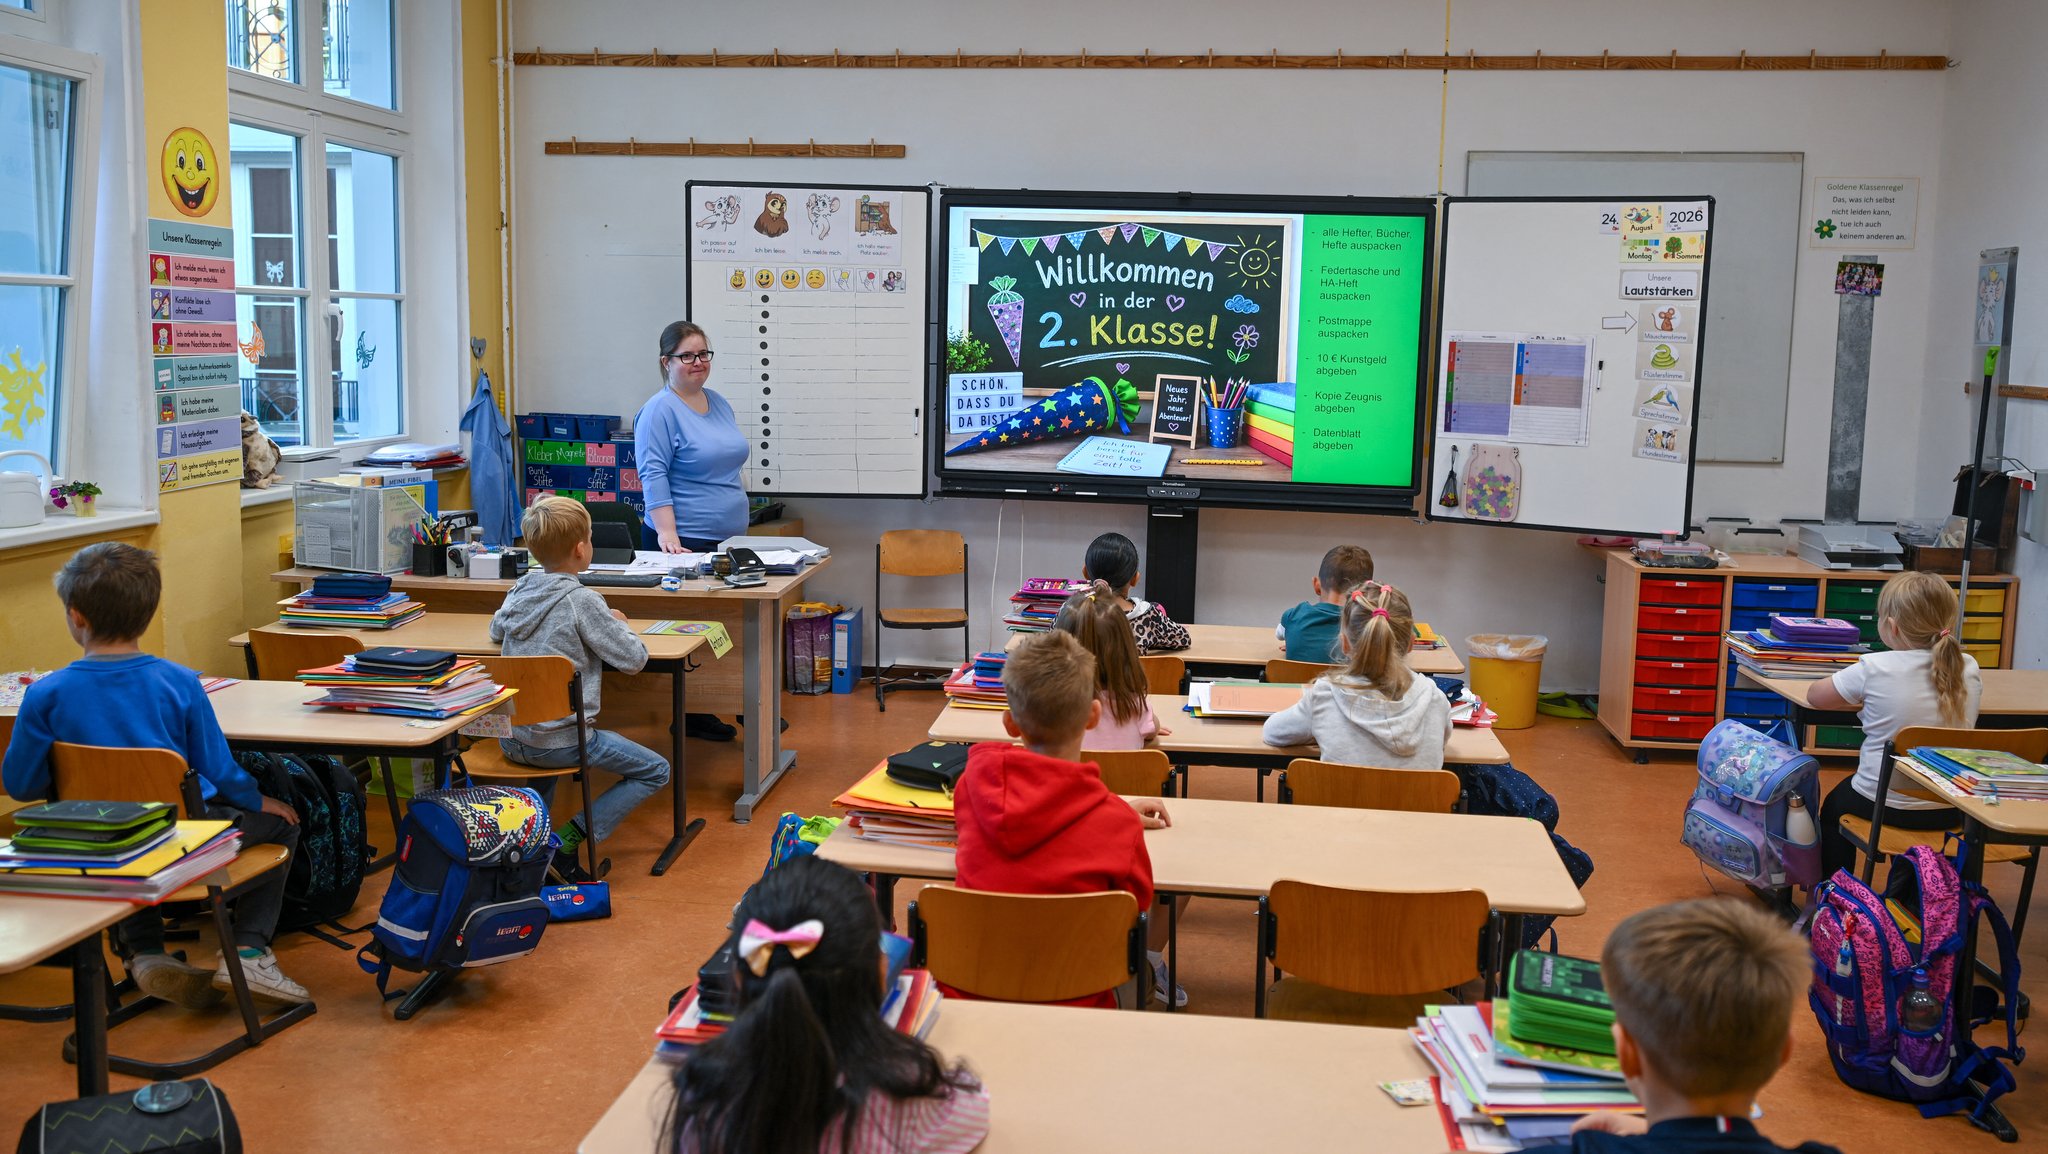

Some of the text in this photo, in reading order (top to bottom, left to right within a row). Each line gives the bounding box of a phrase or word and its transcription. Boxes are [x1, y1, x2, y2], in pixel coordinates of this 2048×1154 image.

[1827, 183, 1904, 192] Goldene Klassenregel
[1832, 196, 1847, 204] Das,
[1601, 214, 1619, 225] 24.
[1669, 210, 1703, 224] 2026
[1322, 228, 1412, 239] alle Hefter, Bücher,
[1630, 224, 1653, 233] August
[162, 232, 222, 250] Unsere Klassenregeln
[1322, 241, 1402, 251] Hefte auspacken
[1627, 252, 1652, 261] Montag
[183, 263, 196, 272] melde
[197, 264, 208, 273] mich,
[1035, 252, 1214, 292] Willkommen
[1321, 266, 1400, 276] Federtasche und
[174, 273, 188, 281] etwas
[189, 276, 202, 284] sagen
[1647, 273, 1671, 281] Unsere
[1320, 279, 1358, 288] HA-Heft
[1624, 286, 1693, 296] Lautstärken
[175, 296, 194, 305] Konflikte
[1099, 291, 1156, 309] in der
[1320, 292, 1371, 301] auspacken
[187, 307, 204, 315] Gewalt.
[1318, 316, 1372, 327] Postmappe
[200, 330, 210, 338] leise,
[1039, 311, 1218, 349] 2. Klasse!
[1318, 330, 1369, 339] auspacken
[1318, 354, 1387, 366] 10 € Kunstgeld
[199, 362, 232, 370] Aufmerksamkeits-
[1316, 367, 1357, 377] abgeben
[1643, 371, 1683, 379] Flüsterstimme
[178, 375, 191, 384] Signal
[1166, 384, 1188, 394] Neues
[189, 397, 200, 405] habe
[1167, 394, 1187, 405] Jahr,
[1315, 391, 1382, 403] Kopie Zeugnis
[957, 396, 1014, 410] DASS DU
[181, 406, 220, 416] Materialien dabei.
[1314, 405, 1355, 414] abgeben
[1158, 412, 1191, 422] Abenteuer!
[1641, 409, 1680, 422] Sprechstimme
[958, 416, 973, 428] DA
[188, 430, 205, 439] erledige
[1313, 428, 1361, 438] Datenblatt
[181, 440, 212, 449] Hausaufgaben.
[1313, 442, 1353, 451] abgeben
[527, 446, 553, 461] Kleber
[1096, 446, 1125, 454] bereit
[1642, 450, 1677, 460] Hundestimme
[555, 450, 585, 462] Magnete
[189, 463, 198, 472] gehe
[224, 457, 239, 465] eigenen
[1093, 460, 1122, 468] Zeit!
[191, 471, 206, 480] fremden
[207, 469, 221, 477] Sachen
[528, 466, 549, 475] Bunt-
[594, 468, 613, 480] Filz-
[389, 476, 422, 486] MEINE FIBEL
[533, 475, 553, 488] Stifte
[587, 478, 607, 489] Stifte
[548, 893, 571, 901] team
